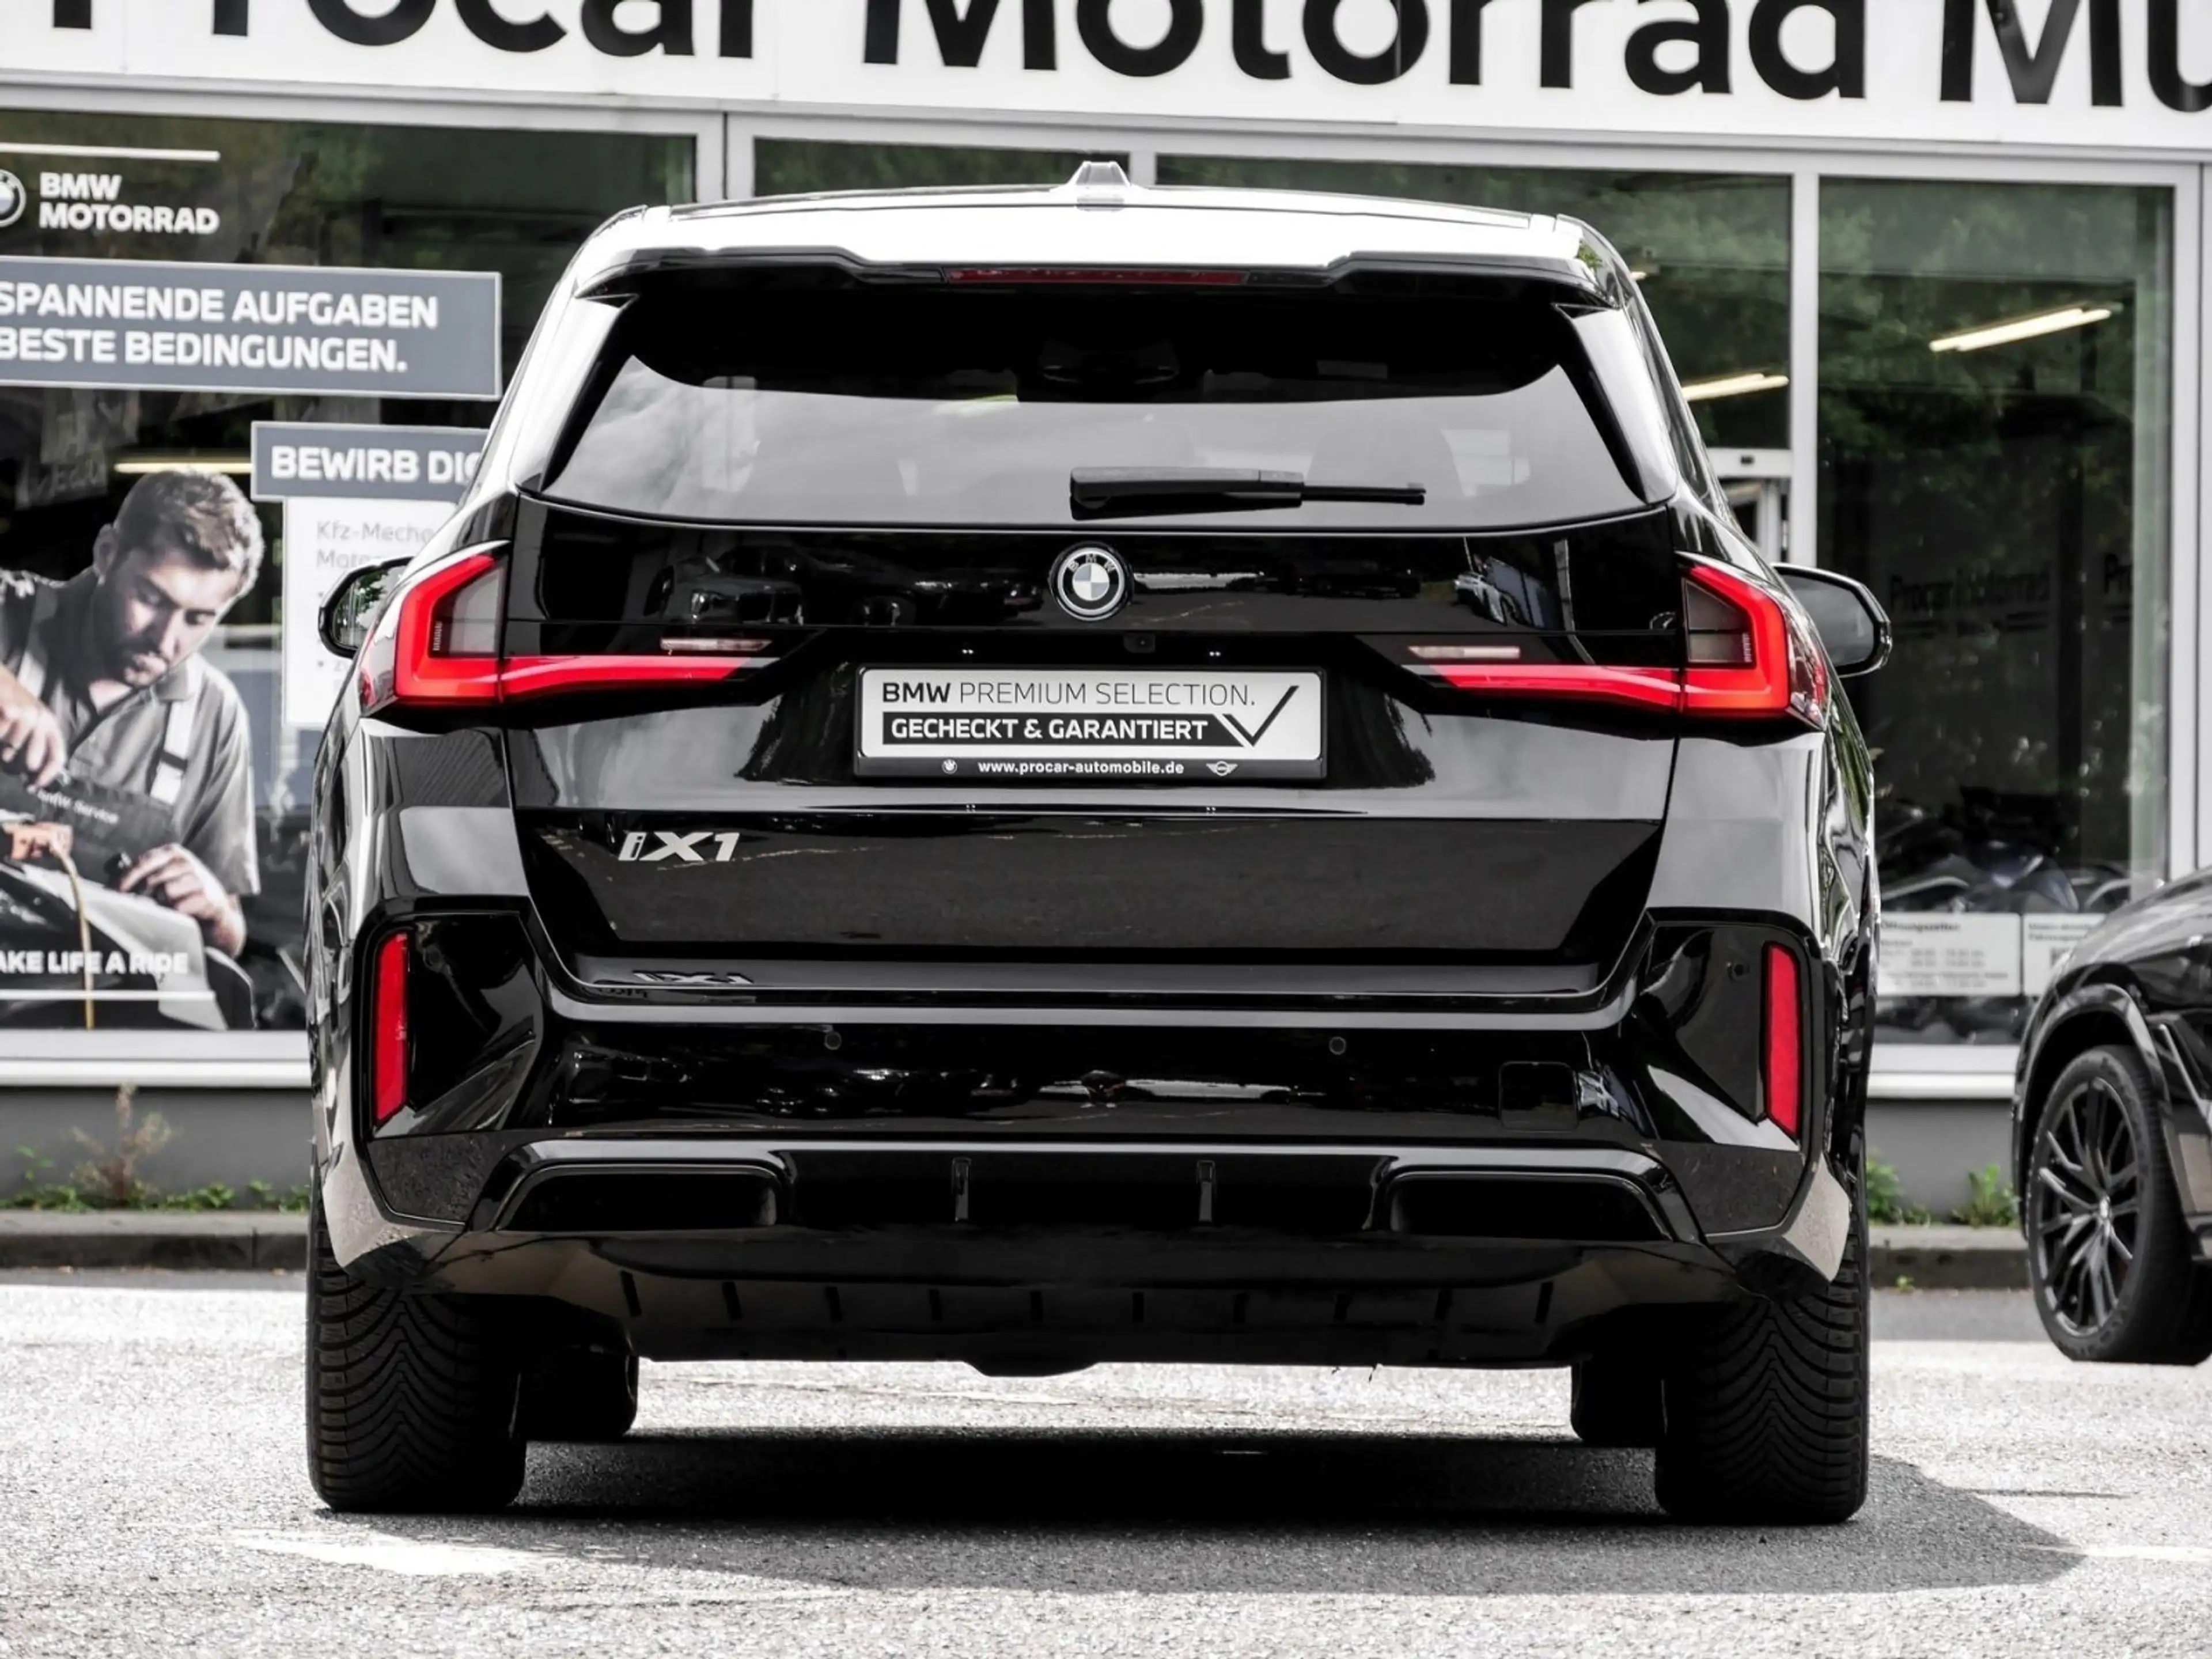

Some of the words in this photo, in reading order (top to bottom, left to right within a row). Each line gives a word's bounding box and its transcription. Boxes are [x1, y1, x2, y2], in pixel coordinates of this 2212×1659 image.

[40, 172, 122, 200] BMW
[39, 202, 221, 234] MOTORRAD
[0, 282, 225, 321] SPANNENDE
[232, 290, 438, 329] AUFGABEN
[0, 327, 117, 362] BESTE
[124, 330, 407, 372] BEDINGUNGEN.
[271, 445, 420, 483] BEWIRB
[1066, 552, 1117, 573] BMW
[881, 682, 952, 704] BMW
[960, 682, 1086, 704] PREMIUM
[1095, 683, 1255, 706] SELECTION.
[891, 718, 1018, 739] GECHECKT
[1023, 718, 1042, 740] &
[1048, 719, 1209, 740] GARANTIERT
[978, 760, 1184, 775] www.procar-automobile.de
[618, 831, 740, 862] iX1
[48, 950, 103, 974] LIFE
[105, 950, 126, 974] A
[129, 952, 188, 975] RIDE
